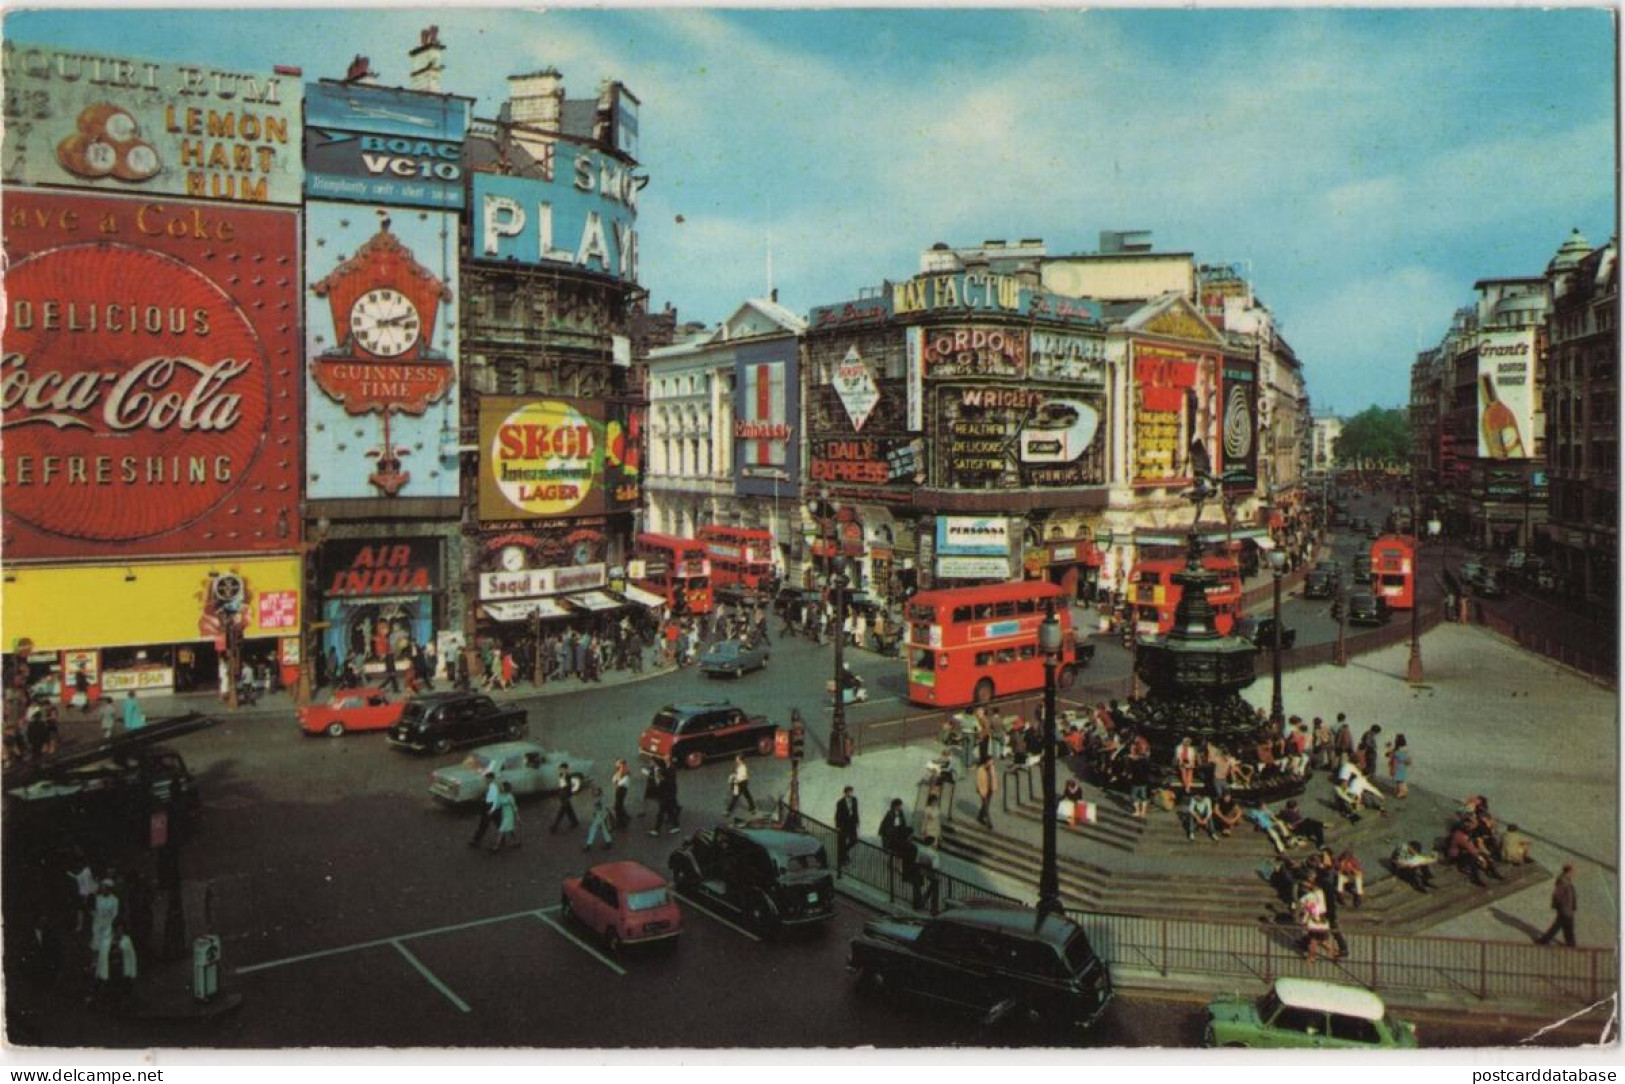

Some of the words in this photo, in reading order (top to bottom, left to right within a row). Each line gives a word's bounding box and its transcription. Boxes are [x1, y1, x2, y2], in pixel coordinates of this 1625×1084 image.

[179, 66, 281, 105] RUM
[165, 104, 288, 144] LEMON
[180, 138, 276, 173] HART
[360, 136, 460, 159] BOAC
[362, 154, 460, 180] VC10
[187, 171, 268, 201] RUM
[99, 209, 120, 233] a
[137, 203, 236, 240] Coke
[893, 279, 927, 313] MAX
[14, 301, 211, 335] DELICIOUS
[333, 365, 437, 381] GUINNESS
[360, 381, 411, 397] TIME
[519, 484, 579, 501] LAGER
[351, 544, 411, 568] AIR
[330, 568, 429, 596] INDIA
